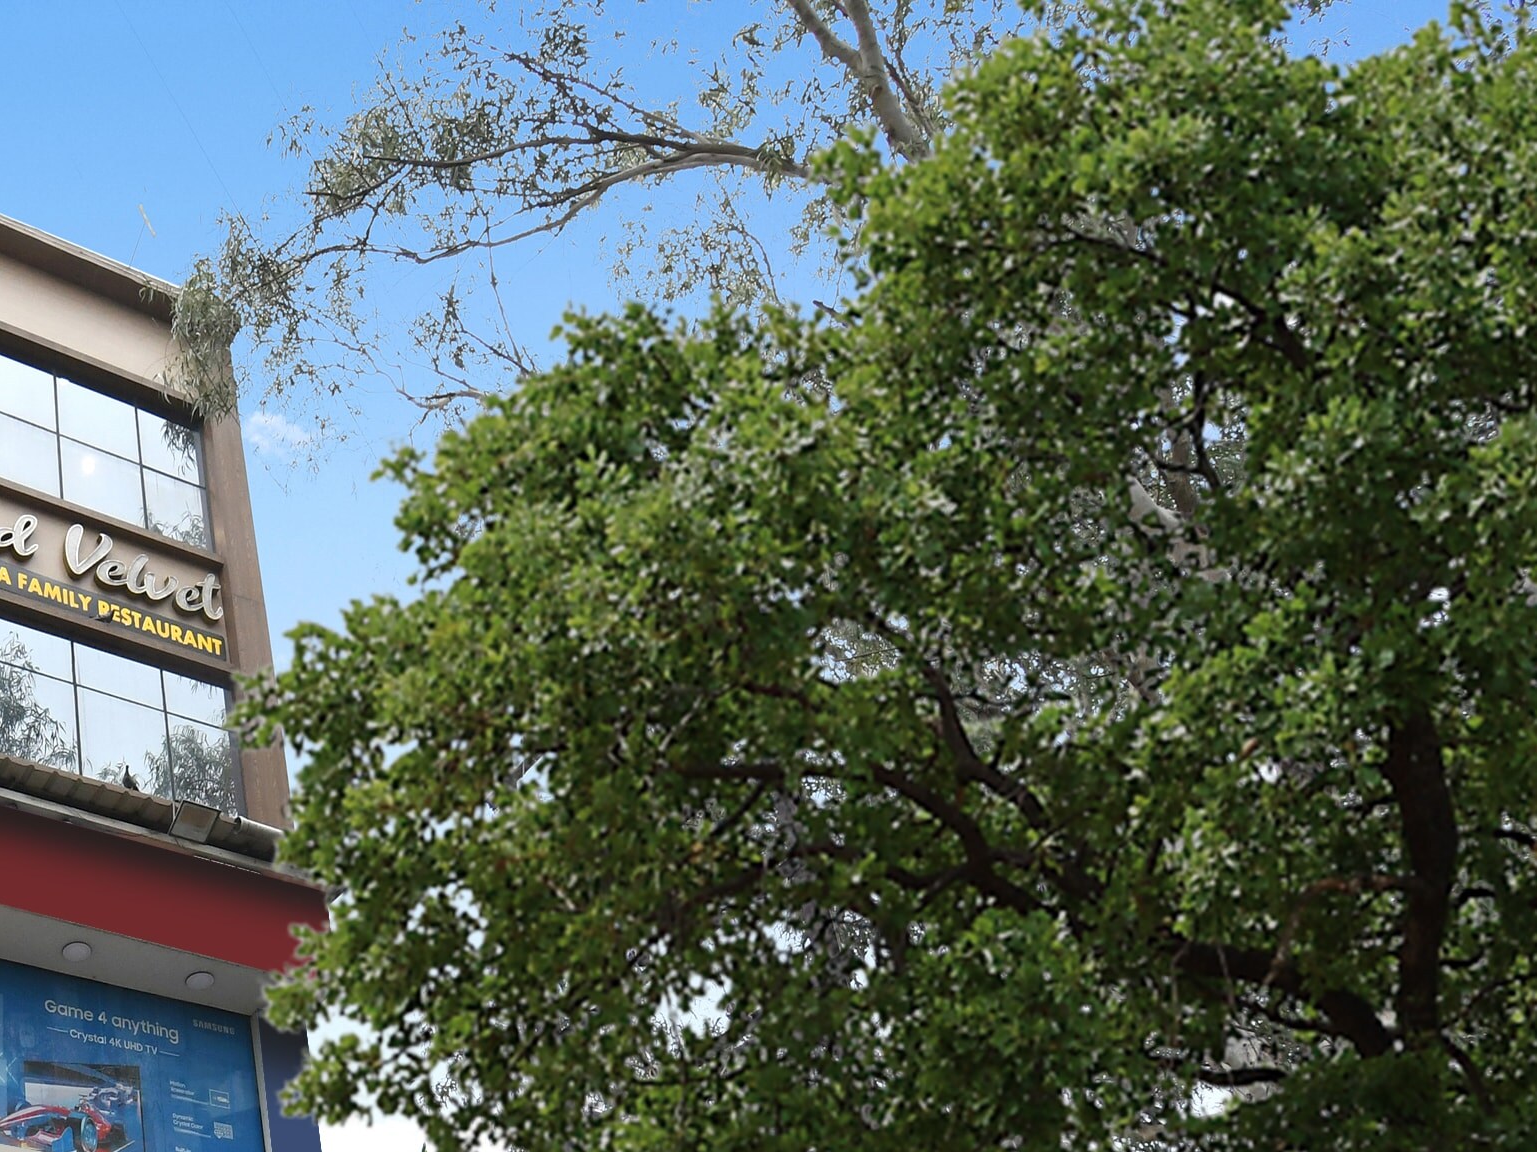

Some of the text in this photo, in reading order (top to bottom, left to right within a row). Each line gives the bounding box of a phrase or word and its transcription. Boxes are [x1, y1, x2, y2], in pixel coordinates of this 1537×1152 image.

[64, 523, 224, 623] Velvet
[18, 573, 93, 612] FAMILY
[97, 599, 223, 656] RESTAURANT
[44, 999, 180, 1044] Game 4 anything
[69, 1028, 158, 1056] Crystal 4K UHD TV
[192, 1019, 235, 1035] SAMSUNG
